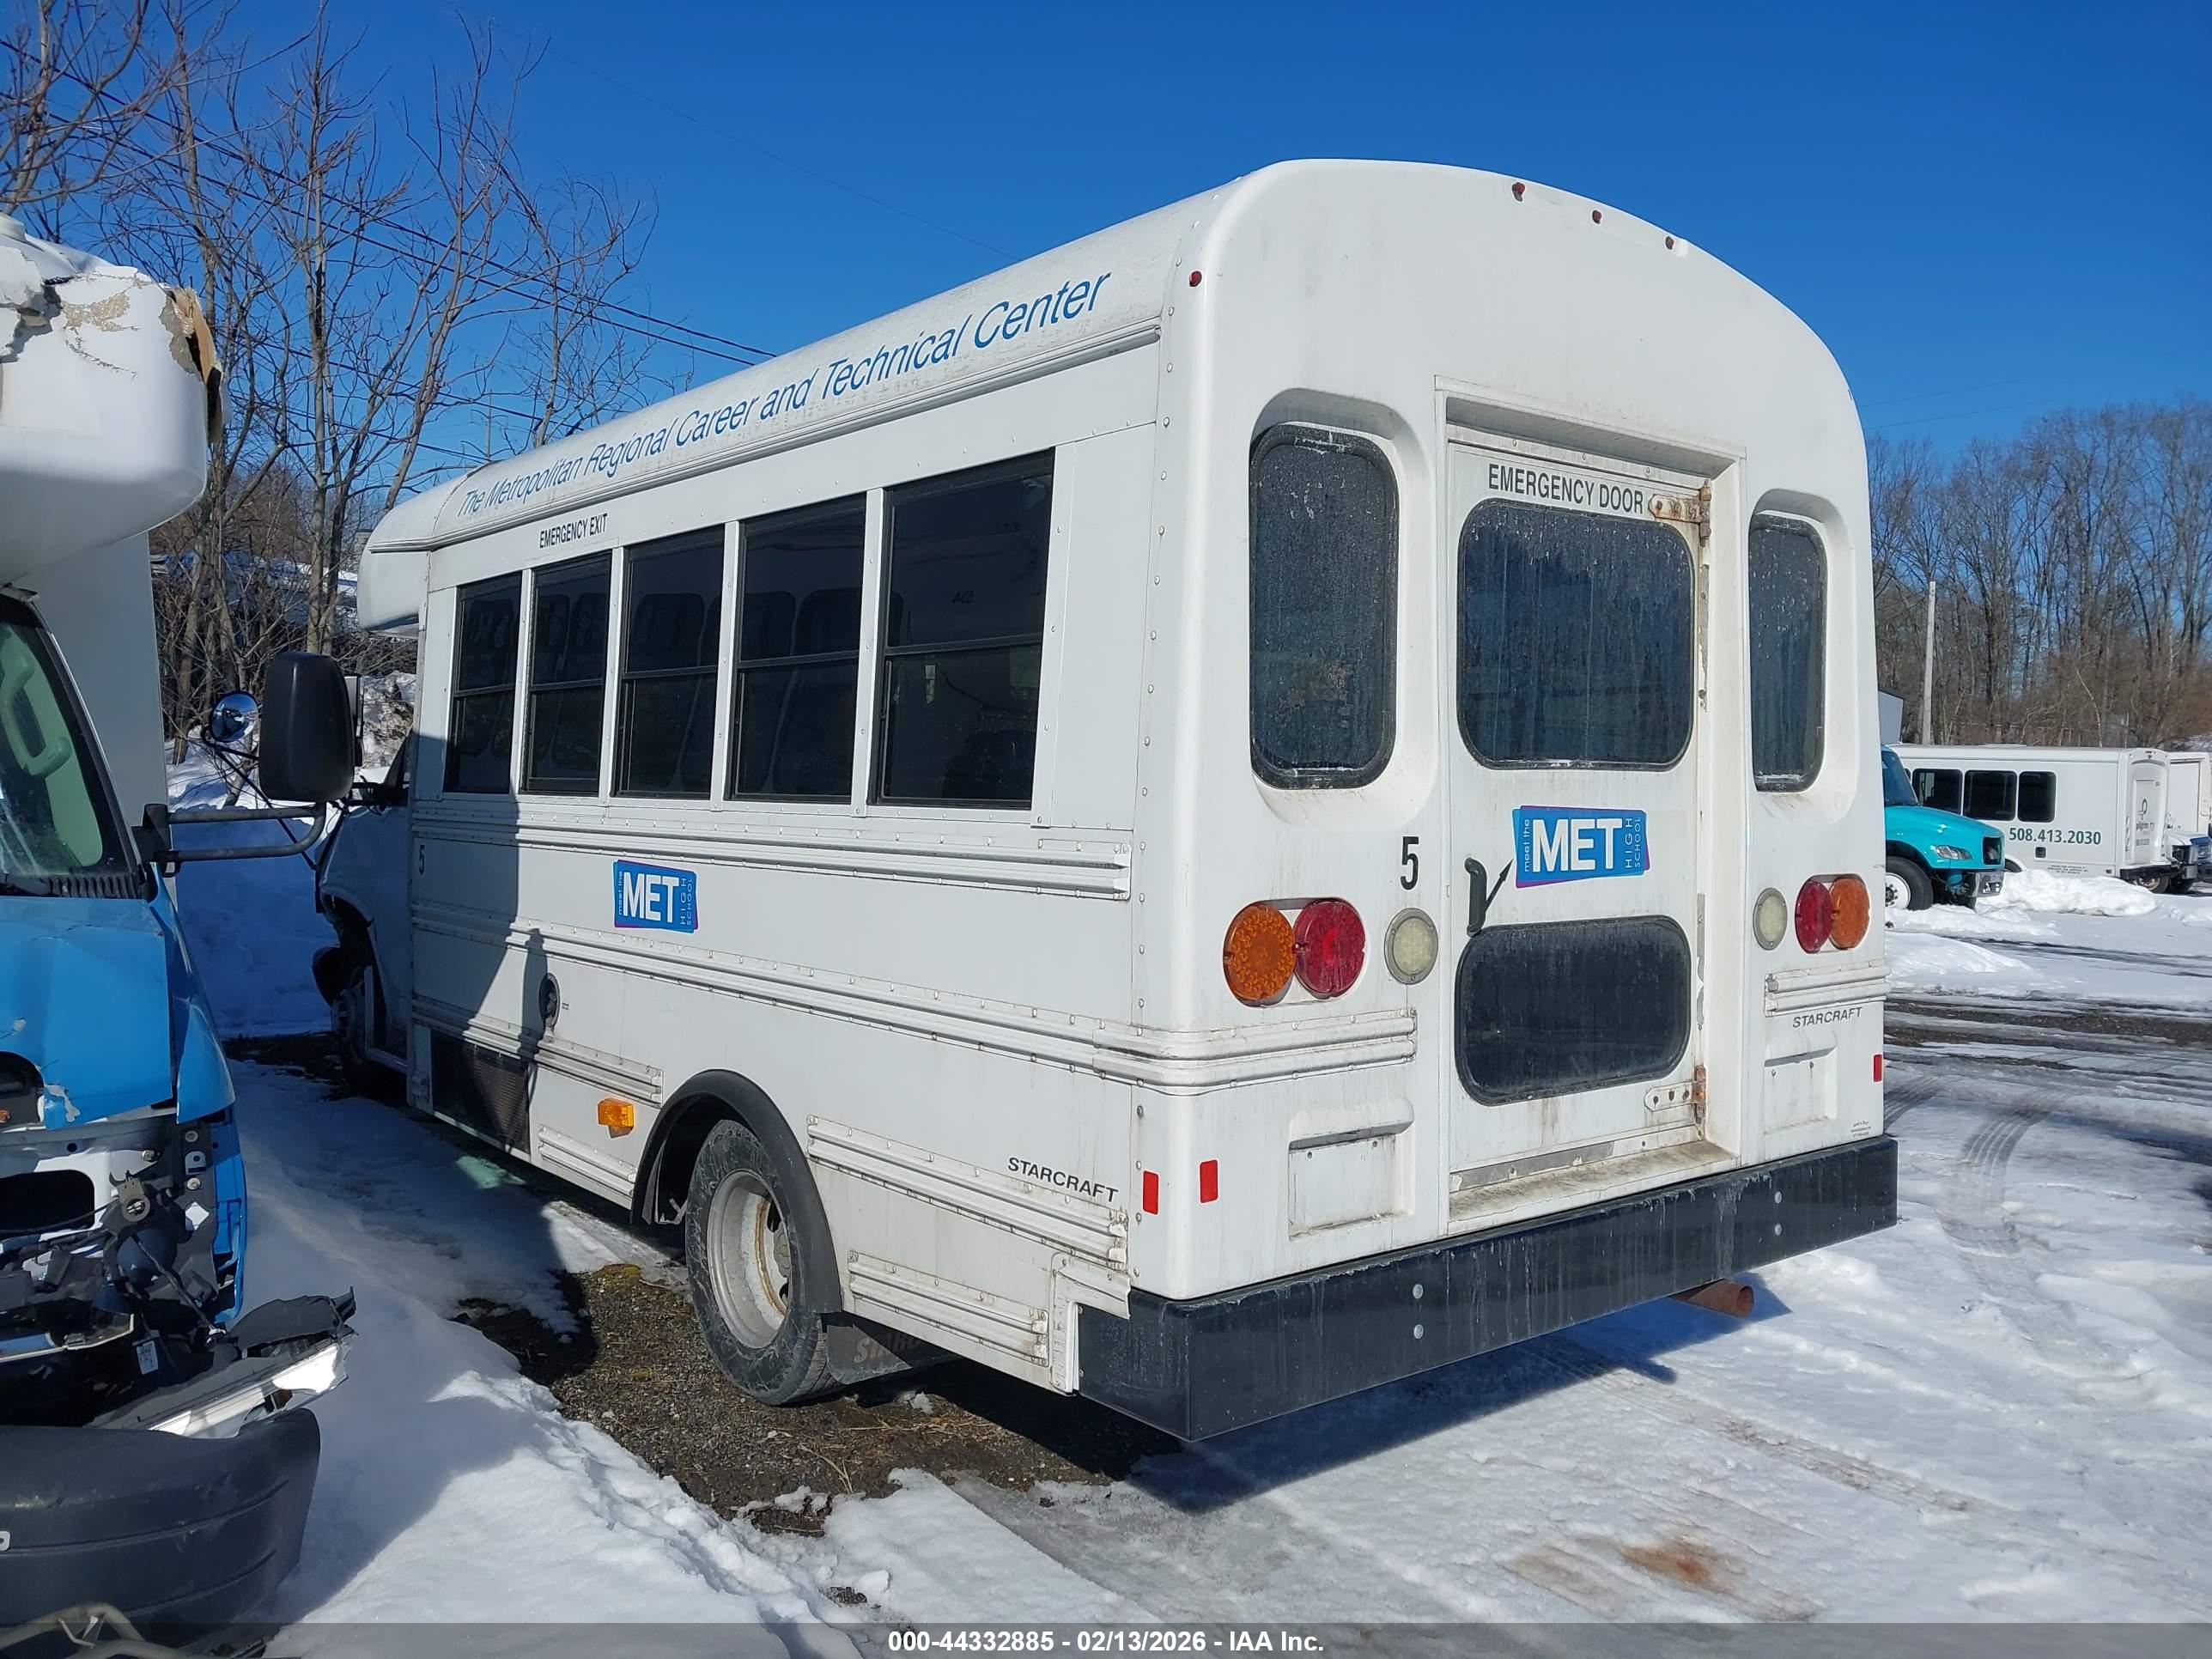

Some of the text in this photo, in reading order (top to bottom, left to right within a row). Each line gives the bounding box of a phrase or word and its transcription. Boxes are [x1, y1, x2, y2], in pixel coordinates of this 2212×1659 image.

[458, 271, 1112, 517] The Metropolitan Regional Career and Technical Center
[1488, 463, 1644, 514] EMERGENCY DOOR
[539, 513, 608, 549] EMERGENCY EXIT
[418, 844, 425, 875] 5
[1532, 817, 1623, 872] MET
[2008, 827, 2102, 845] 508.413.2030
[1400, 836, 1419, 890] 5
[623, 872, 680, 923] MET
[1792, 1006, 1863, 1028] STARCRAFT
[1007, 1157, 1119, 1203] STARCRAFT
